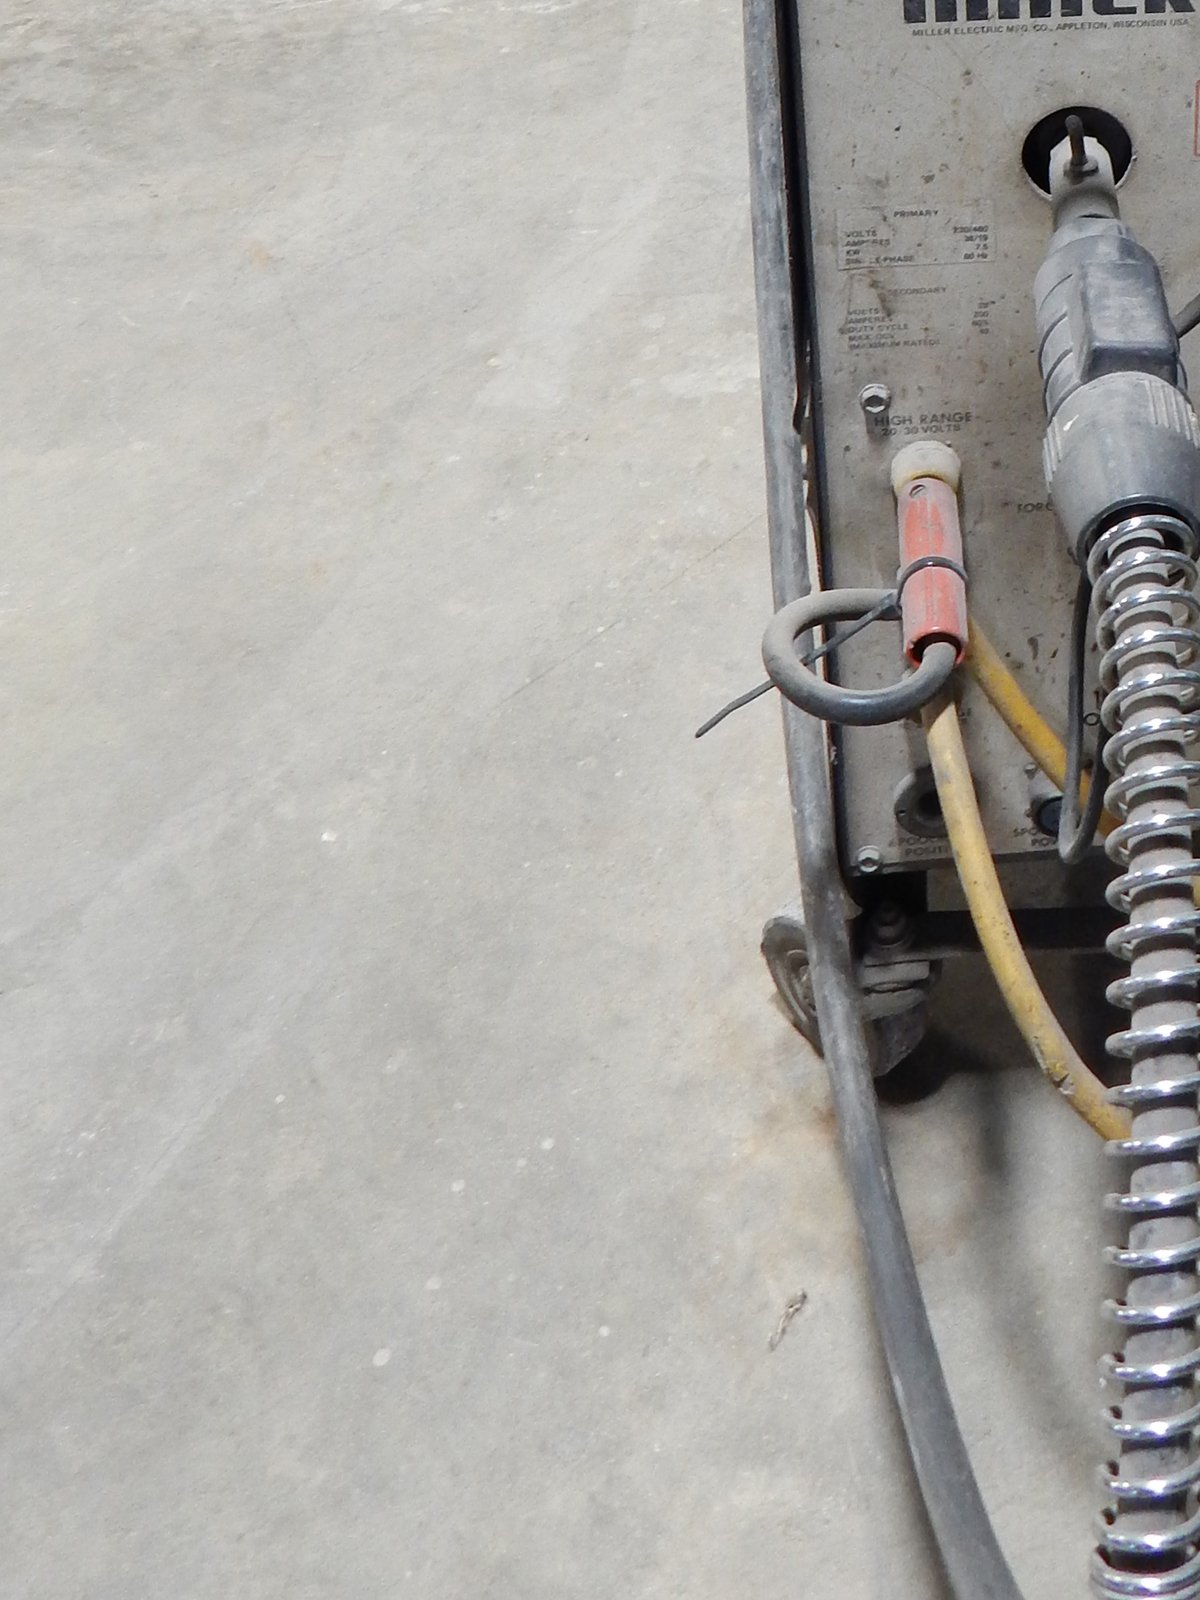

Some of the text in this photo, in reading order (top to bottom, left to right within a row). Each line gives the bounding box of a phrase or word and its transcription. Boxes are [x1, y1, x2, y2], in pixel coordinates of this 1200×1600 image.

[912, 27, 951, 37] MILLER
[954, 25, 1004, 35] ELECTRIC
[894, 209, 939, 218] PRIMARY
[846, 229, 877, 238] VOLTS
[887, 287, 947, 297] SECONDARY
[875, 412, 973, 428] HIGH RANGE
[921, 424, 961, 434] VOLTS
